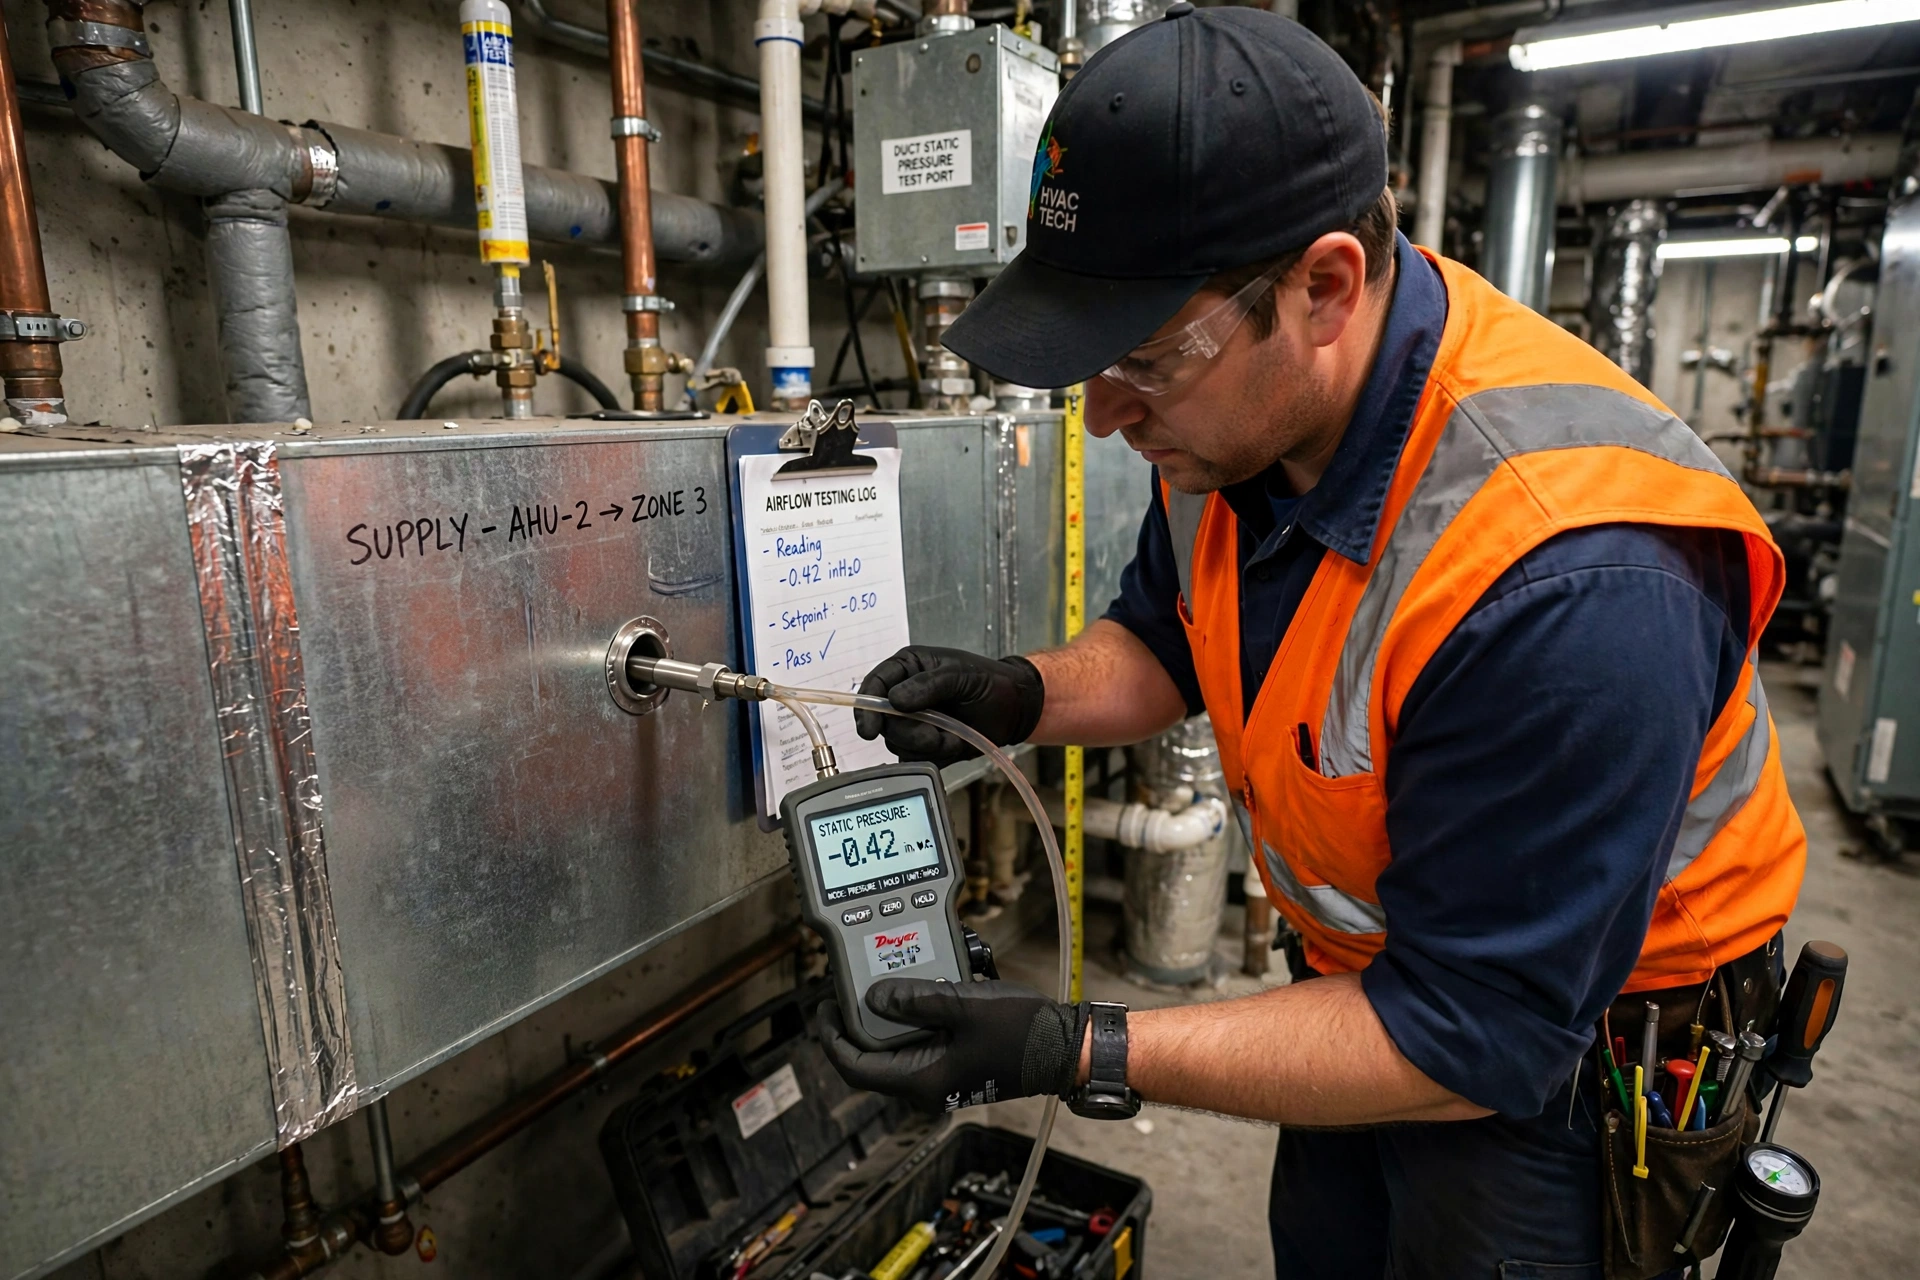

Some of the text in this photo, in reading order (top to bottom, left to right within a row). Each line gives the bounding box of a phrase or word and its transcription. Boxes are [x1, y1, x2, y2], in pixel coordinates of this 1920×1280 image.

[893, 137, 959, 157] DUCT STATIC
[897, 153, 954, 172] PRESSURE
[898, 169, 954, 187] TEST PORT
[1040, 185, 1080, 211] HVAC
[1039, 206, 1077, 232] TECH
[765, 486, 878, 512] AIRFLOW TESTING LOG
[346, 512, 469, 566] SUPPLY
[508, 501, 592, 542] AHU-2
[631, 489, 686, 523] ZONE
[694, 486, 708, 515] 3
[776, 534, 822, 561] Reading
[779, 564, 822, 587] -0.42
[840, 592, 877, 613] -0.50
[785, 648, 812, 670] Pass
[818, 805, 911, 838] STATIC PRESSURE:
[828, 829, 899, 868] -0.42
[882, 901, 902, 914] ZERO
[914, 892, 935, 906] HOLD
